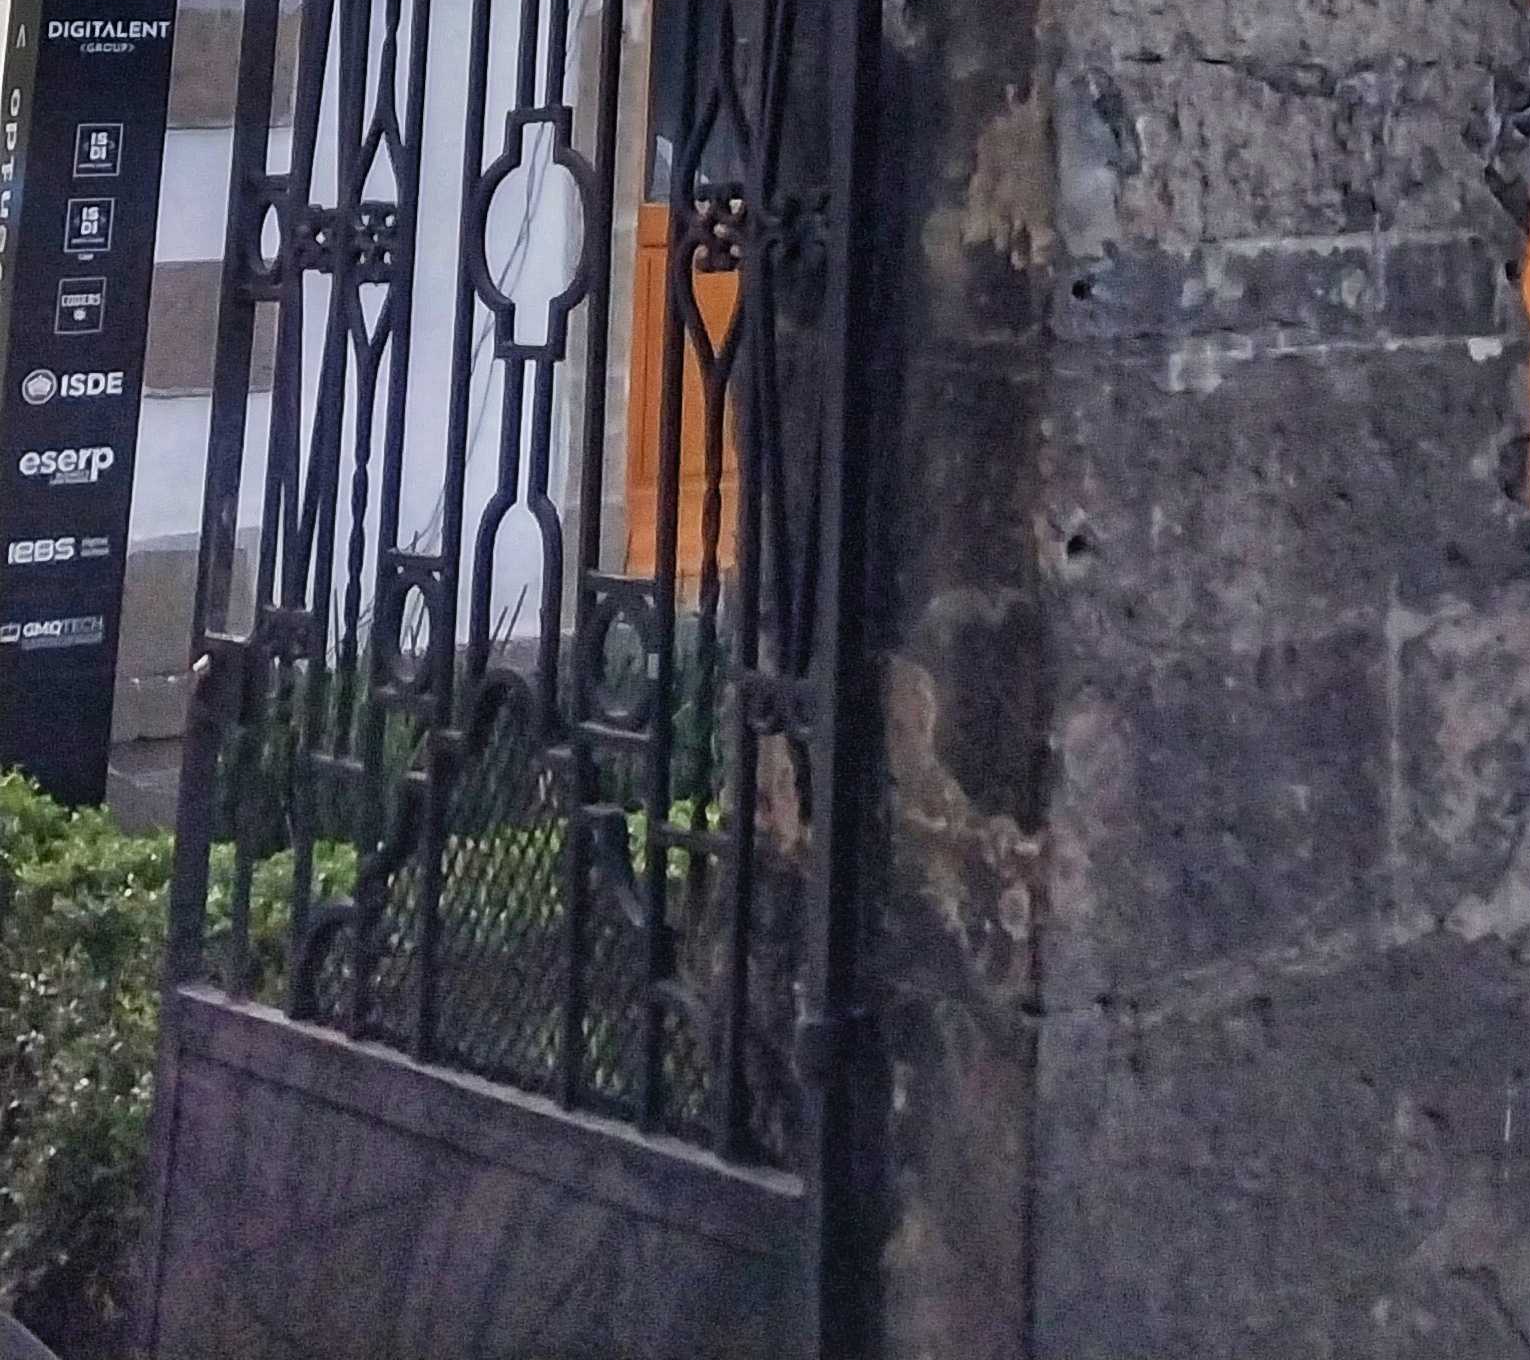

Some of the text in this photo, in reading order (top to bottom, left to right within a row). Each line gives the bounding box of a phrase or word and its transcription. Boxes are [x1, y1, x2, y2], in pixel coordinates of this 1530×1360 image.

[48, 20, 171, 39] DIGITALENT
[60, 372, 124, 397] ISDE
[19, 447, 114, 482] eserp
